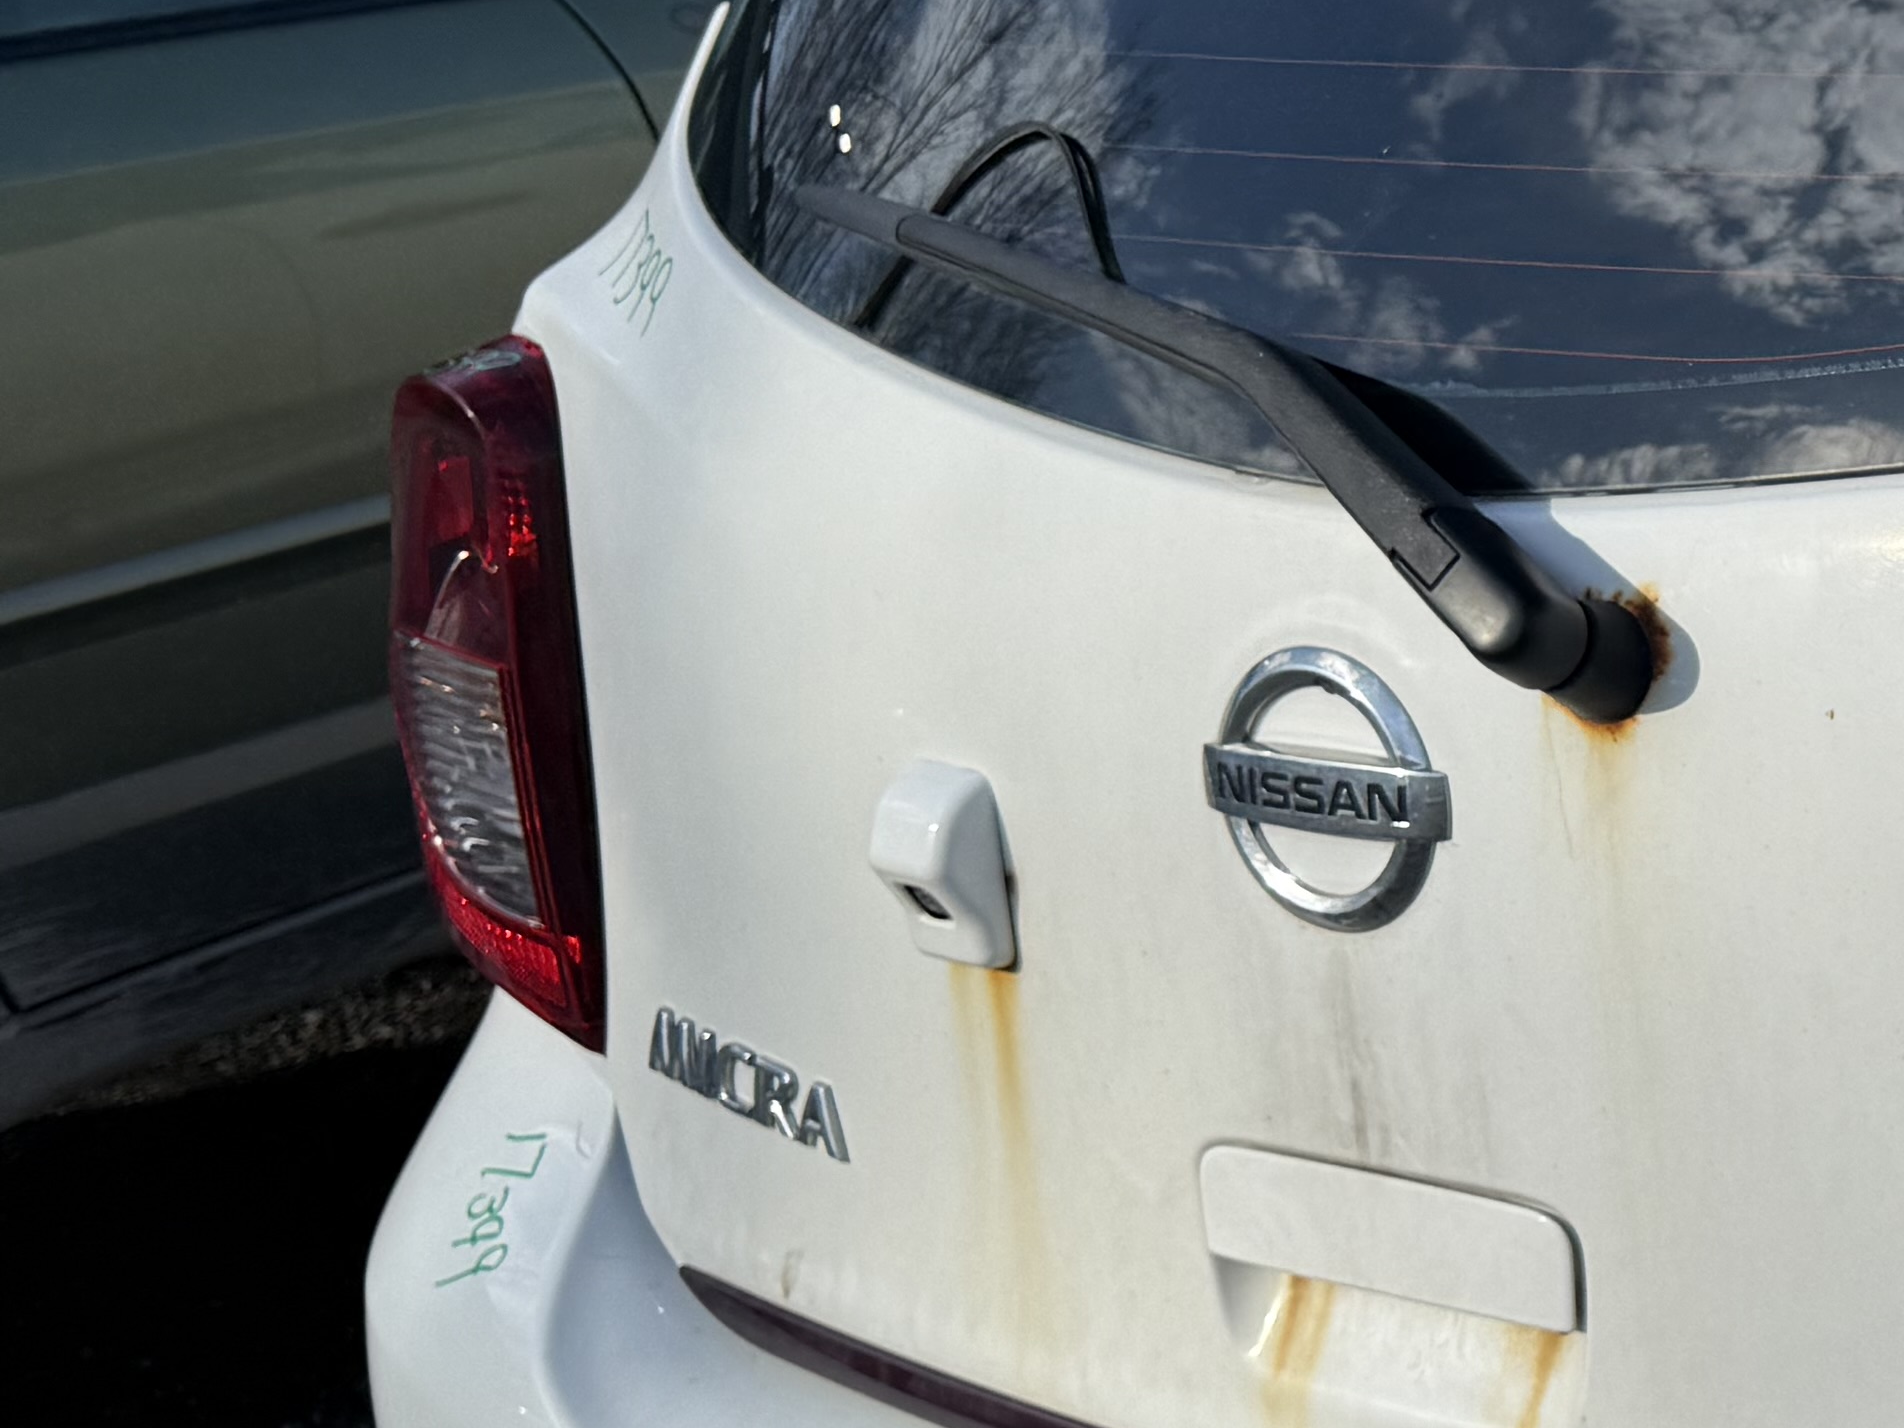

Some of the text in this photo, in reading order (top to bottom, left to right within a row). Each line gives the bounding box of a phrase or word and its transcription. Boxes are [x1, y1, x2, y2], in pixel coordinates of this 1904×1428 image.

[1215, 760, 1410, 824] NISSAN
[648, 1005, 851, 1164] MICRA
[435, 1132, 548, 1288] 17399
